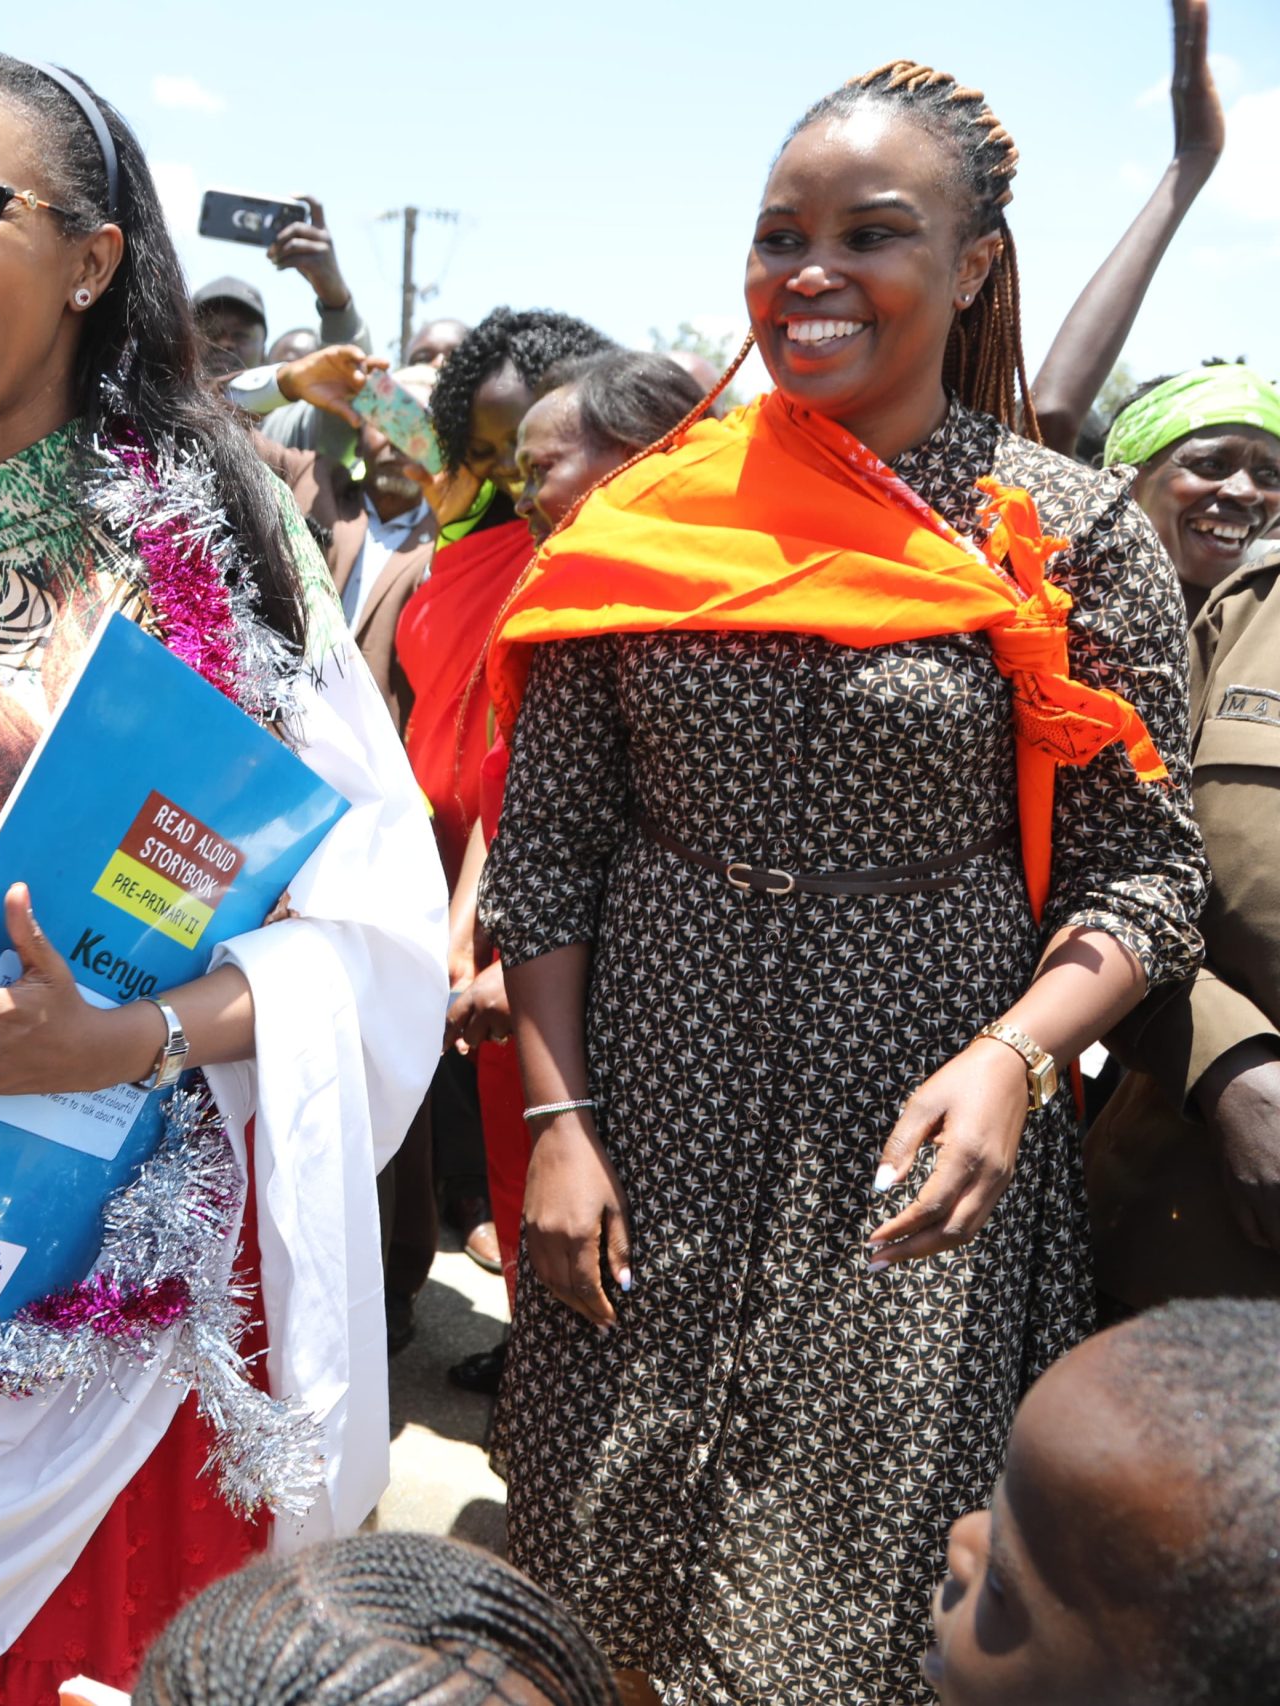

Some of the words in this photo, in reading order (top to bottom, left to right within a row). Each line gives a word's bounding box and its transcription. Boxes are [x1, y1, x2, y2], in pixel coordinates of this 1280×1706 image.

[139, 836, 218, 899] STORYBOOK
[152, 804, 196, 844] READ
[193, 833, 237, 872] ALOUD
[111, 873, 188, 927] PRE-PRIMARY
[185, 916, 200, 935] II
[70, 927, 158, 1000] Kenya
[69, 1099, 79, 1110] to
[79, 1103, 95, 1116] talk
[94, 1109, 115, 1123] about
[115, 1116, 127, 1128] the
[92, 1093, 106, 1104] and
[105, 1097, 135, 1115] colourful
[126, 1088, 142, 1102] easy
